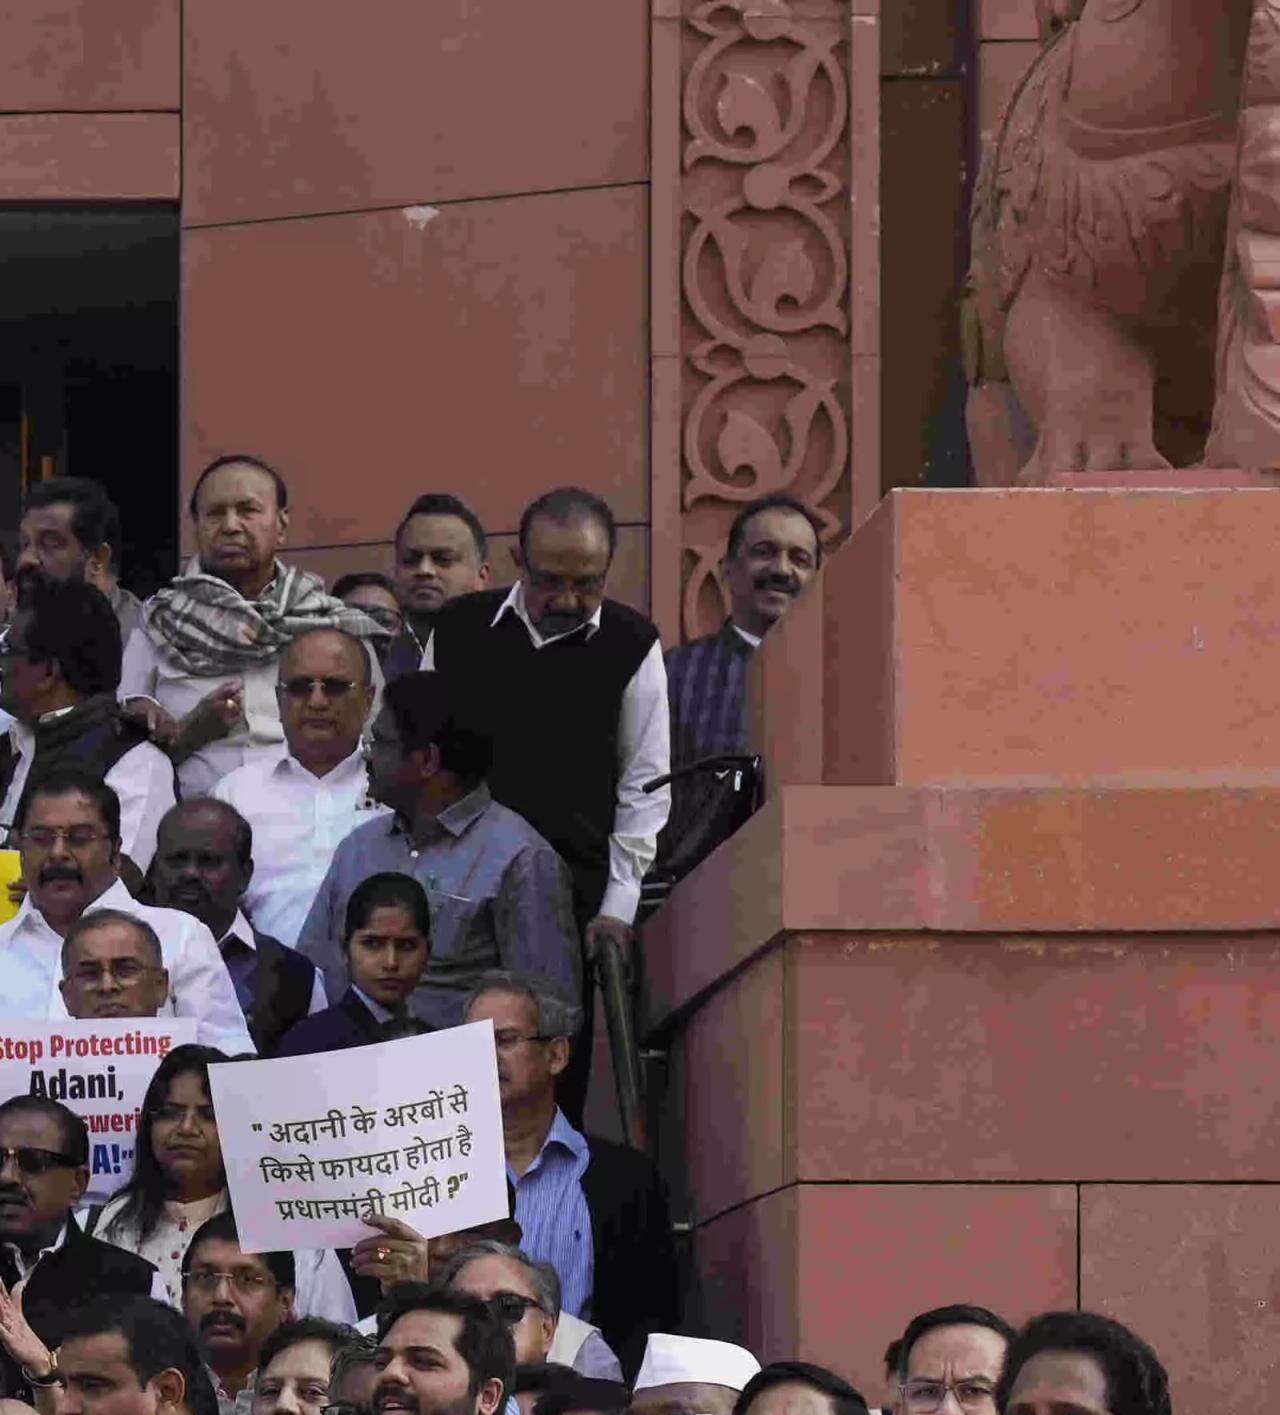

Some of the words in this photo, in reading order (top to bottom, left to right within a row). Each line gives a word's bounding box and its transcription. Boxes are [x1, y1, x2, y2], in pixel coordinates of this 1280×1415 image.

[50, 1031, 172, 1060] Protecting
[30, 1066, 124, 1101] Adani,
[269, 1109, 347, 1144] अदानी
[350, 1106, 376, 1134] के
[384, 1090, 444, 1128] अरबों
[447, 1084, 468, 1114] से
[259, 1154, 315, 1184] किसे
[319, 1149, 400, 1181] फायदा
[403, 1136, 452, 1172] होता
[456, 1124, 473, 1157] है
[275, 1188, 386, 1221] प्रधानमंत्री
[389, 1176, 440, 1212] मोदी
